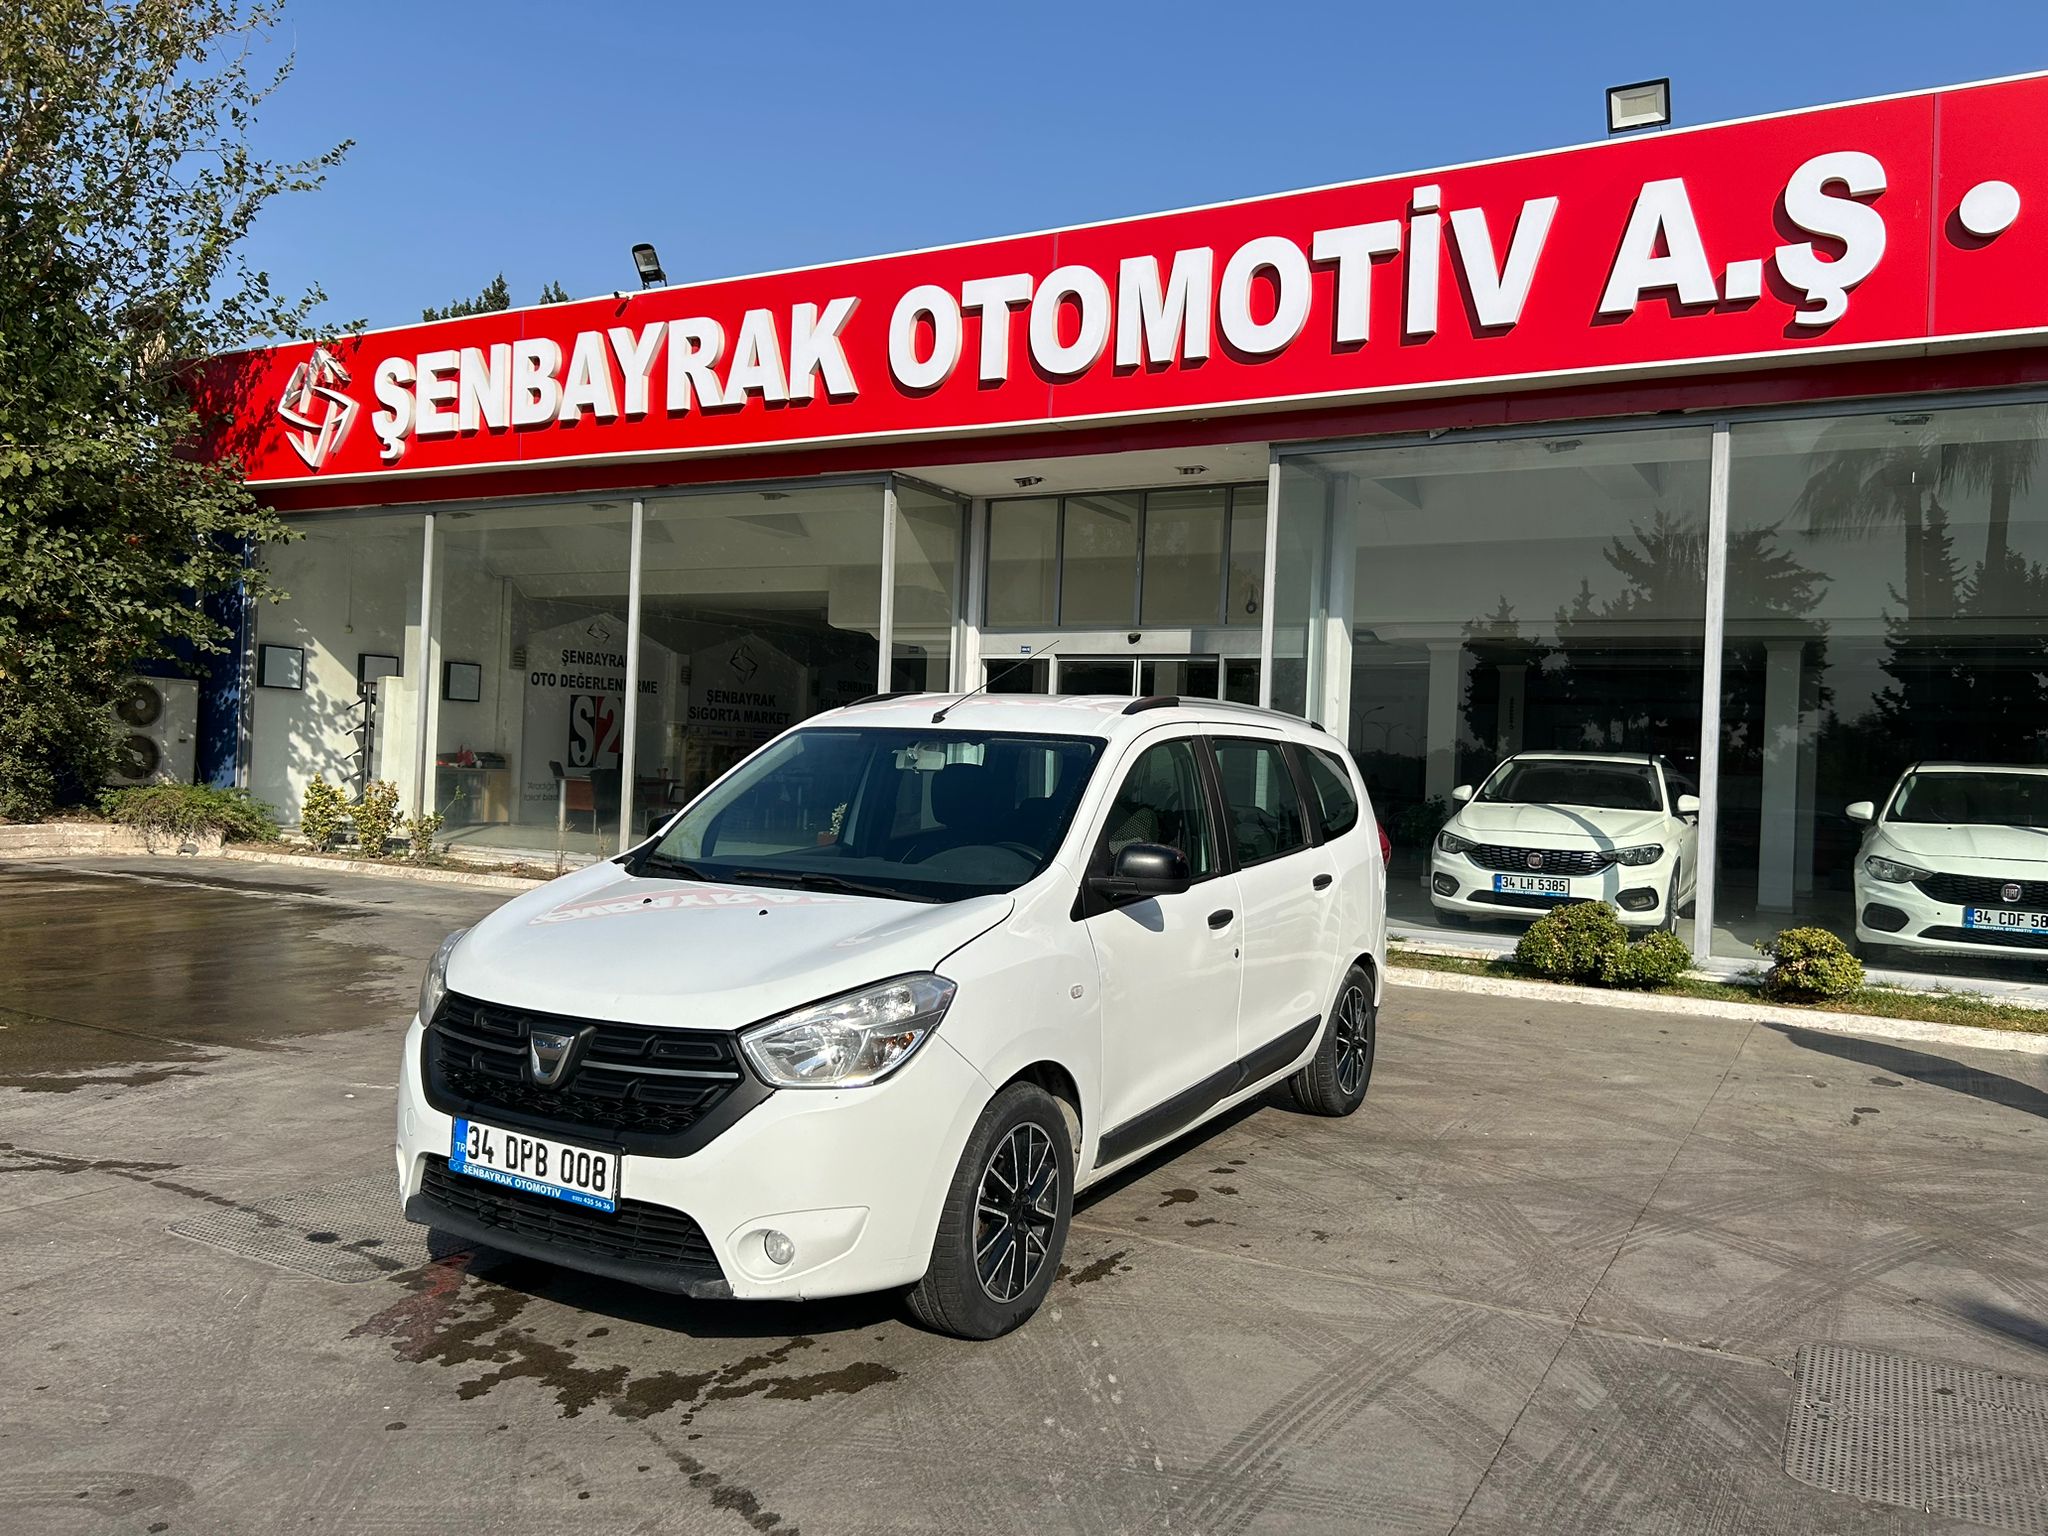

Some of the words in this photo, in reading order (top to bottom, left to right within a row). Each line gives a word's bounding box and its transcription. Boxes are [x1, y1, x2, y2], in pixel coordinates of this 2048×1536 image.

[371, 296, 861, 460] ŞENBAYRAK
[888, 184, 1560, 389] OTOMOTİV
[1598, 150, 1888, 327] A.Ş
[561, 649, 627, 667] ŞENBAYRA
[531, 672, 557, 687] OTO
[560, 673, 658, 694] DEĞERLENRME
[706, 689, 776, 707] ŞENBAYRAK
[743, 710, 791, 725] MARKET
[1502, 876, 1515, 888] 34
[1520, 878, 1533, 890] LH
[1538, 879, 1566, 892] 5385
[1974, 909, 1992, 924] 34
[1999, 911, 2026, 926] CDF
[455, 1141, 466, 1153] TR
[467, 1125, 495, 1164] 34
[506, 1134, 548, 1177] DPB
[560, 1148, 607, 1192] 008
